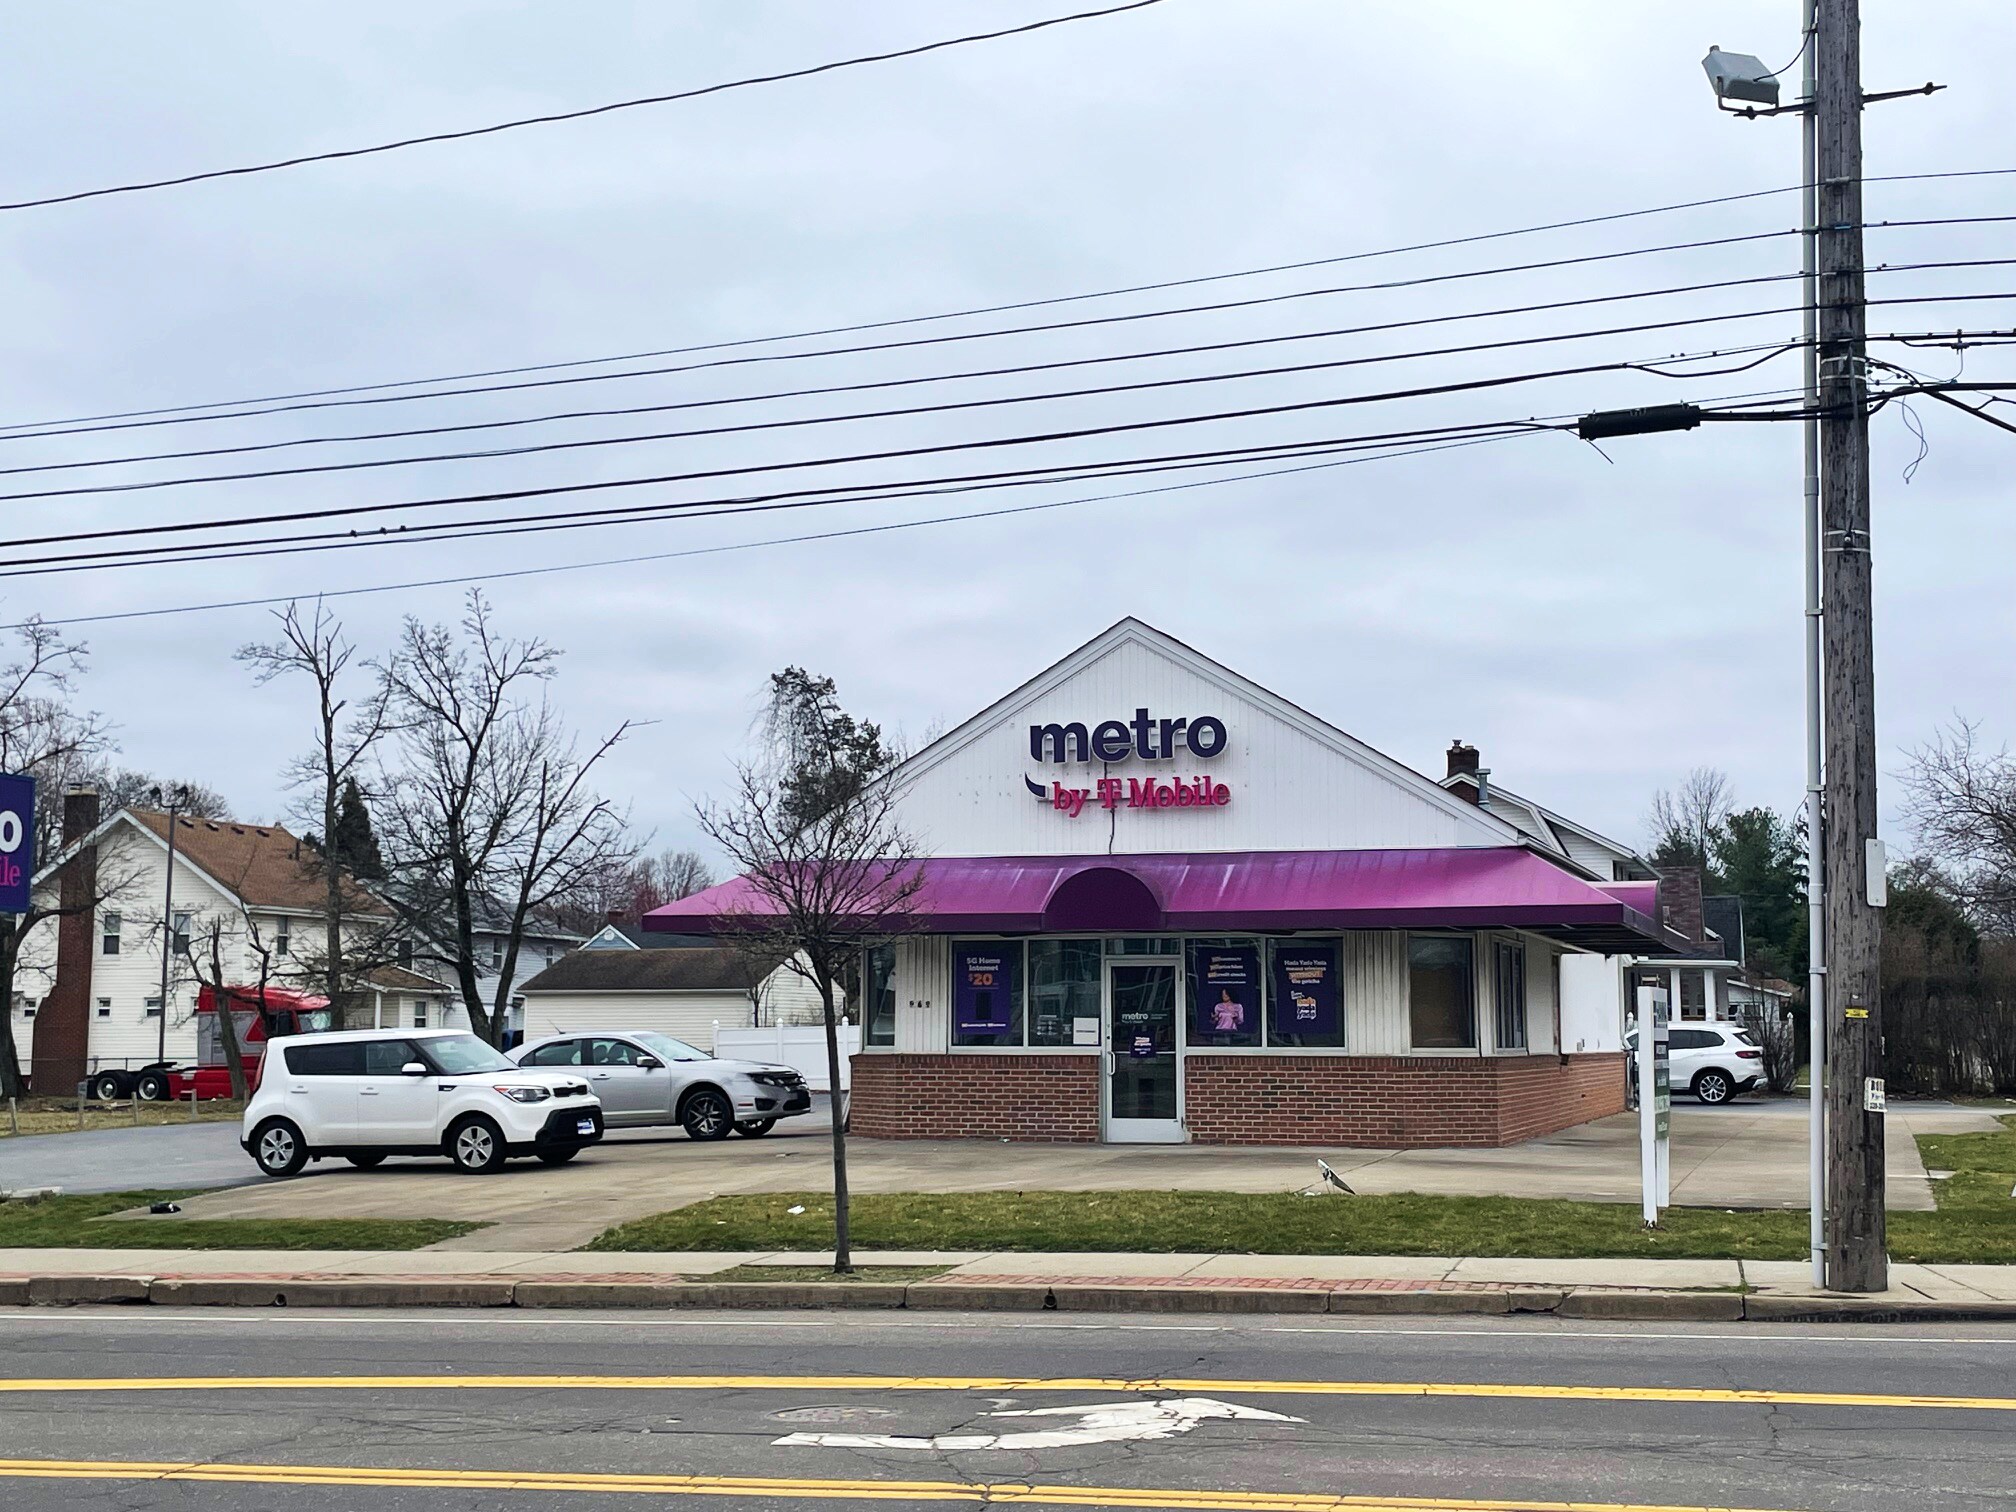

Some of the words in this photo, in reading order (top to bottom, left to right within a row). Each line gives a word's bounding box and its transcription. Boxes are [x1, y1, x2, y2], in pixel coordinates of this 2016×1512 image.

[1030, 708, 1227, 763] metro
[1052, 781, 1089, 818] by
[1127, 776, 1231, 807] Mobile
[1121, 1012, 1149, 1020] metro
